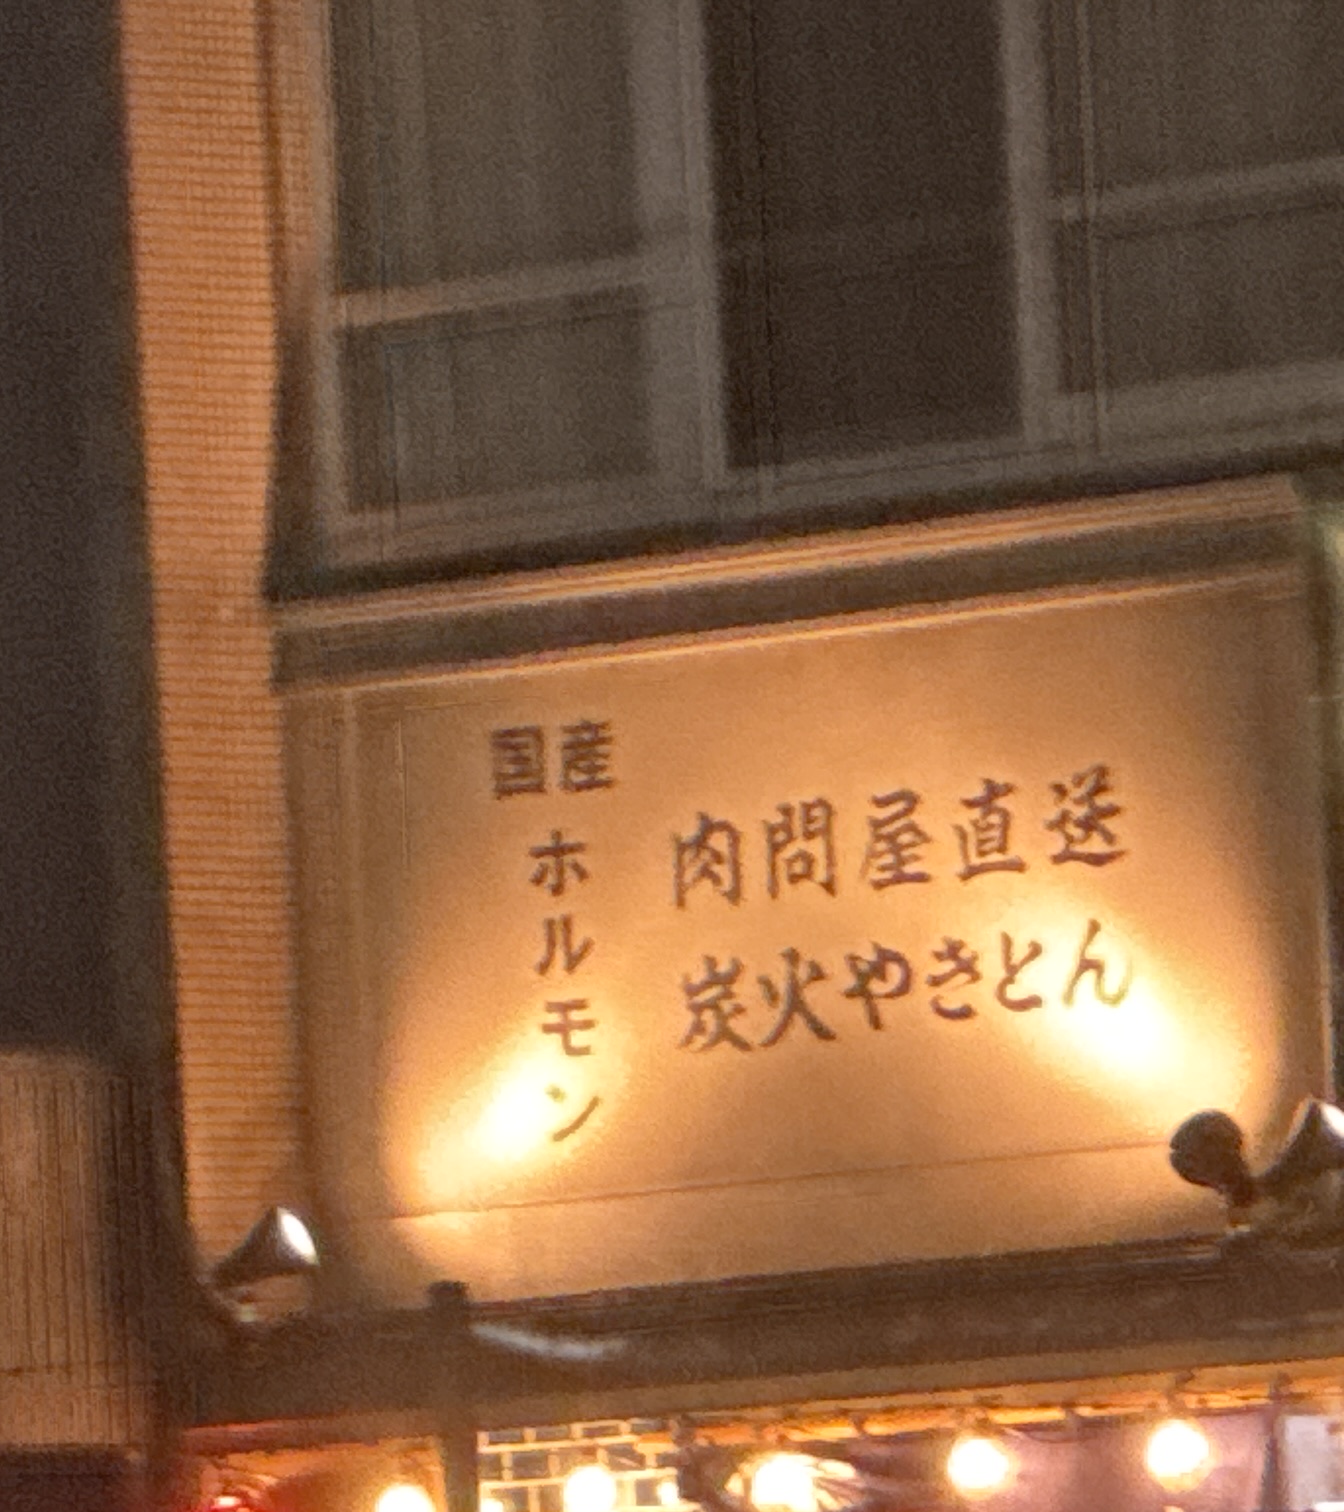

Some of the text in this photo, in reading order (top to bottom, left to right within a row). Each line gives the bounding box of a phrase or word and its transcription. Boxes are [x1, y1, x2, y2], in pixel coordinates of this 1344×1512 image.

[490, 719, 617, 801] 国産
[670, 763, 1127, 909] 肉問屋直送
[528, 827, 600, 1143] ホルモン
[677, 917, 1132, 1053] 炭火やきとん
